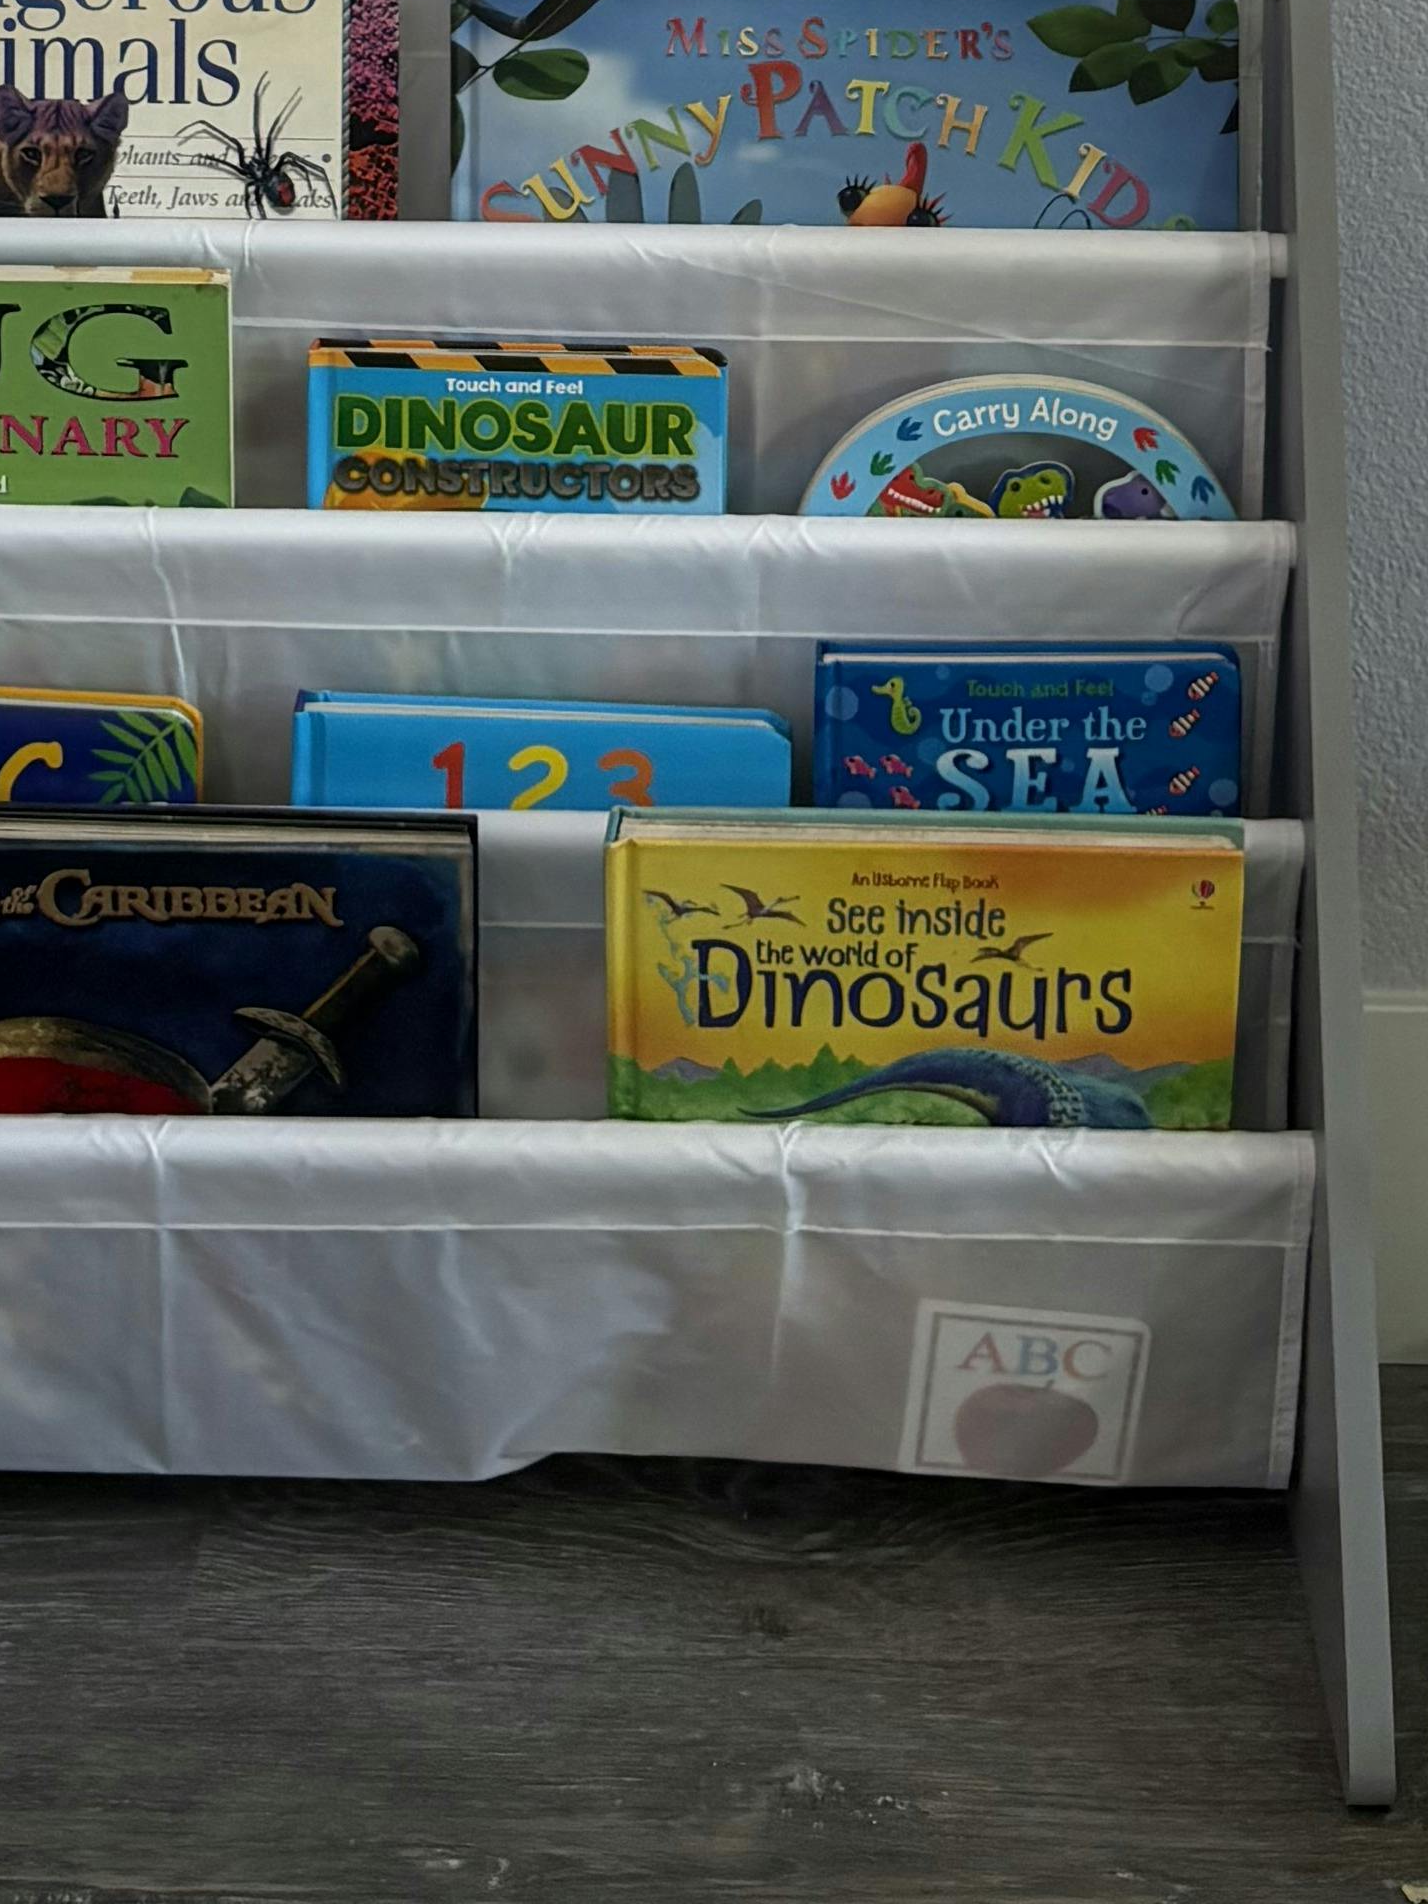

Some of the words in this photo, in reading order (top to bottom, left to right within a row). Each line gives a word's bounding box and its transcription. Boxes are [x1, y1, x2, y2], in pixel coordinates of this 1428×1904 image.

[739, 59, 988, 156] PATCH
[167, 186, 219, 210] Jaws
[445, 377, 502, 394] Touch
[504, 379, 542, 395] and
[545, 380, 584, 395] Feel
[334, 394, 697, 458] DINOSAUR
[932, 402, 1021, 437] Carry
[1029, 396, 1119, 442] Along
[333, 456, 702, 503] CONSTRUCTORS
[966, 679, 1024, 698] Touch
[1030, 680, 1070, 698] and
[1074, 679, 1115, 698] Feel
[938, 705, 1071, 743] Under
[1082, 705, 1148, 742] the
[935, 746, 1139, 814] SEA
[35, 867, 345, 928] CARIBBEAN
[851, 871, 871, 887] An
[872, 871, 931, 889] Usborne
[932, 871, 961, 895] Flap
[962, 874, 1001, 890] Book
[826, 896, 886, 936] See
[897, 897, 1007, 942] inside
[756, 938, 794, 965] the
[799, 940, 879, 970] world
[884, 941, 920, 974] of
[690, 937, 1134, 1041] Dinosaurs
[955, 1330, 1114, 1382] ABC
